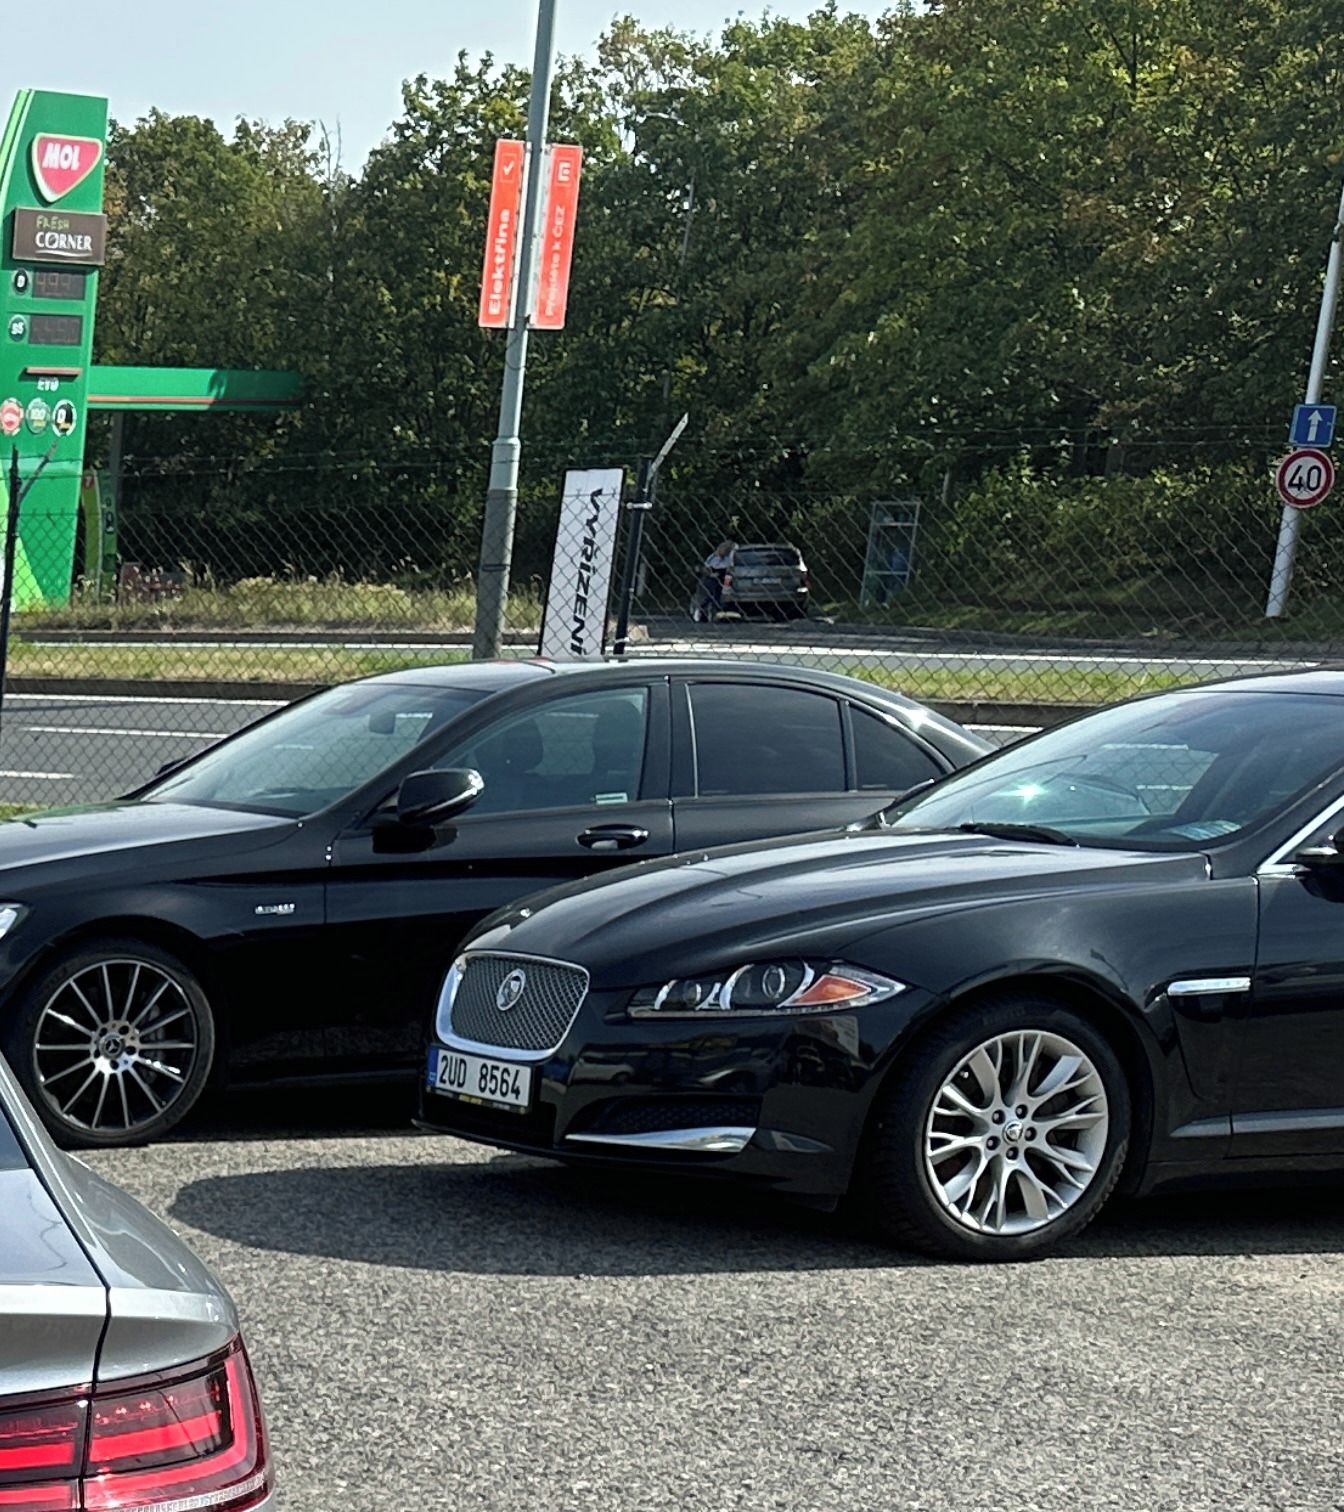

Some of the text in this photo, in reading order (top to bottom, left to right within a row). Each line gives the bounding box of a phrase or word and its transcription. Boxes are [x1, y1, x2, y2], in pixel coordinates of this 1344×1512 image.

[41, 142, 80, 171] MOL
[36, 215, 70, 231] FRESH
[35, 231, 93, 252] CORNER
[488, 208, 511, 316] Elektřina
[1287, 464, 1322, 492] 40
[570, 488, 603, 656] VYŘÍZENÍ
[438, 1054, 521, 1100] 2UD 8564
